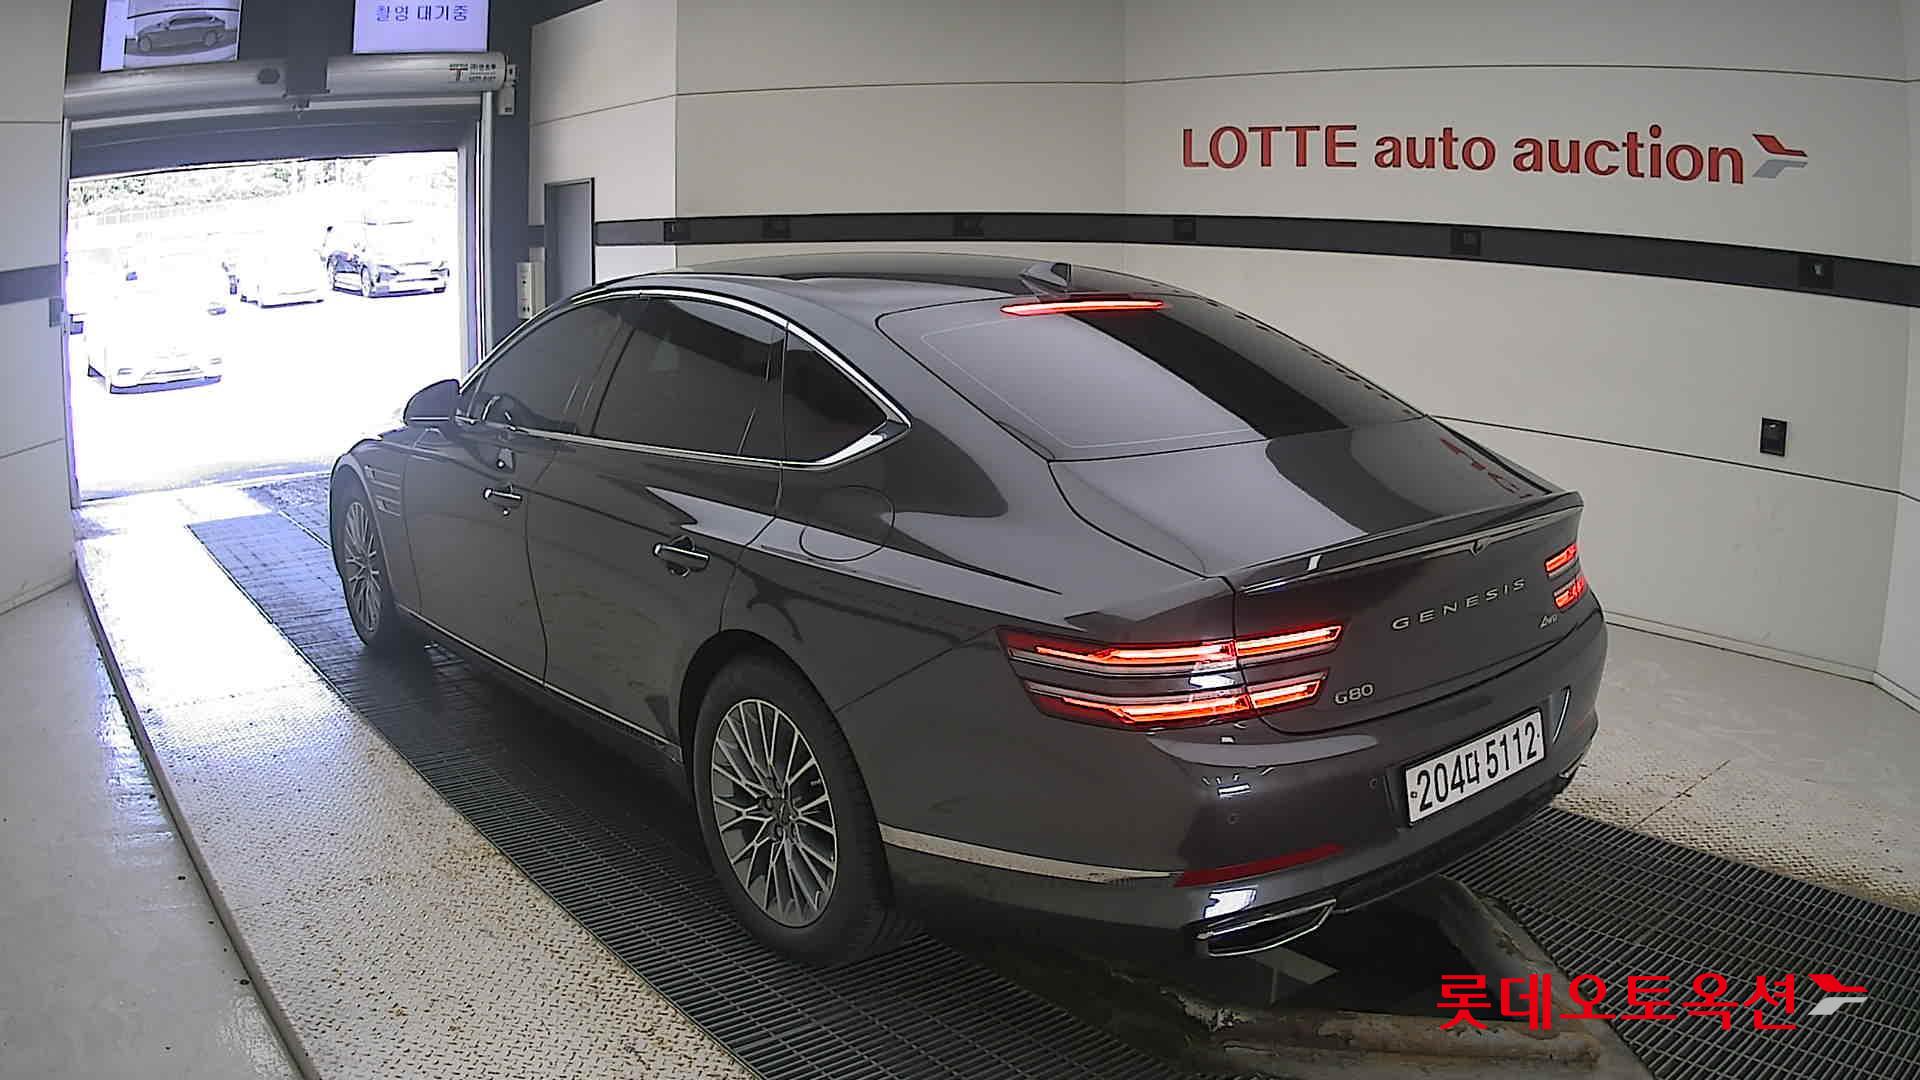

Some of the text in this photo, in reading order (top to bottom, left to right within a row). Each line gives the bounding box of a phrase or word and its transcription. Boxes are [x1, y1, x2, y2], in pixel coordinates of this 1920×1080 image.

[417, 4, 468, 21] 대기중
[1181, 124, 1746, 184] LOTTE auto auction
[1391, 578, 1526, 630] GENESIS
[1334, 684, 1375, 705] G80
[1485, 721, 1537, 779] 5112
